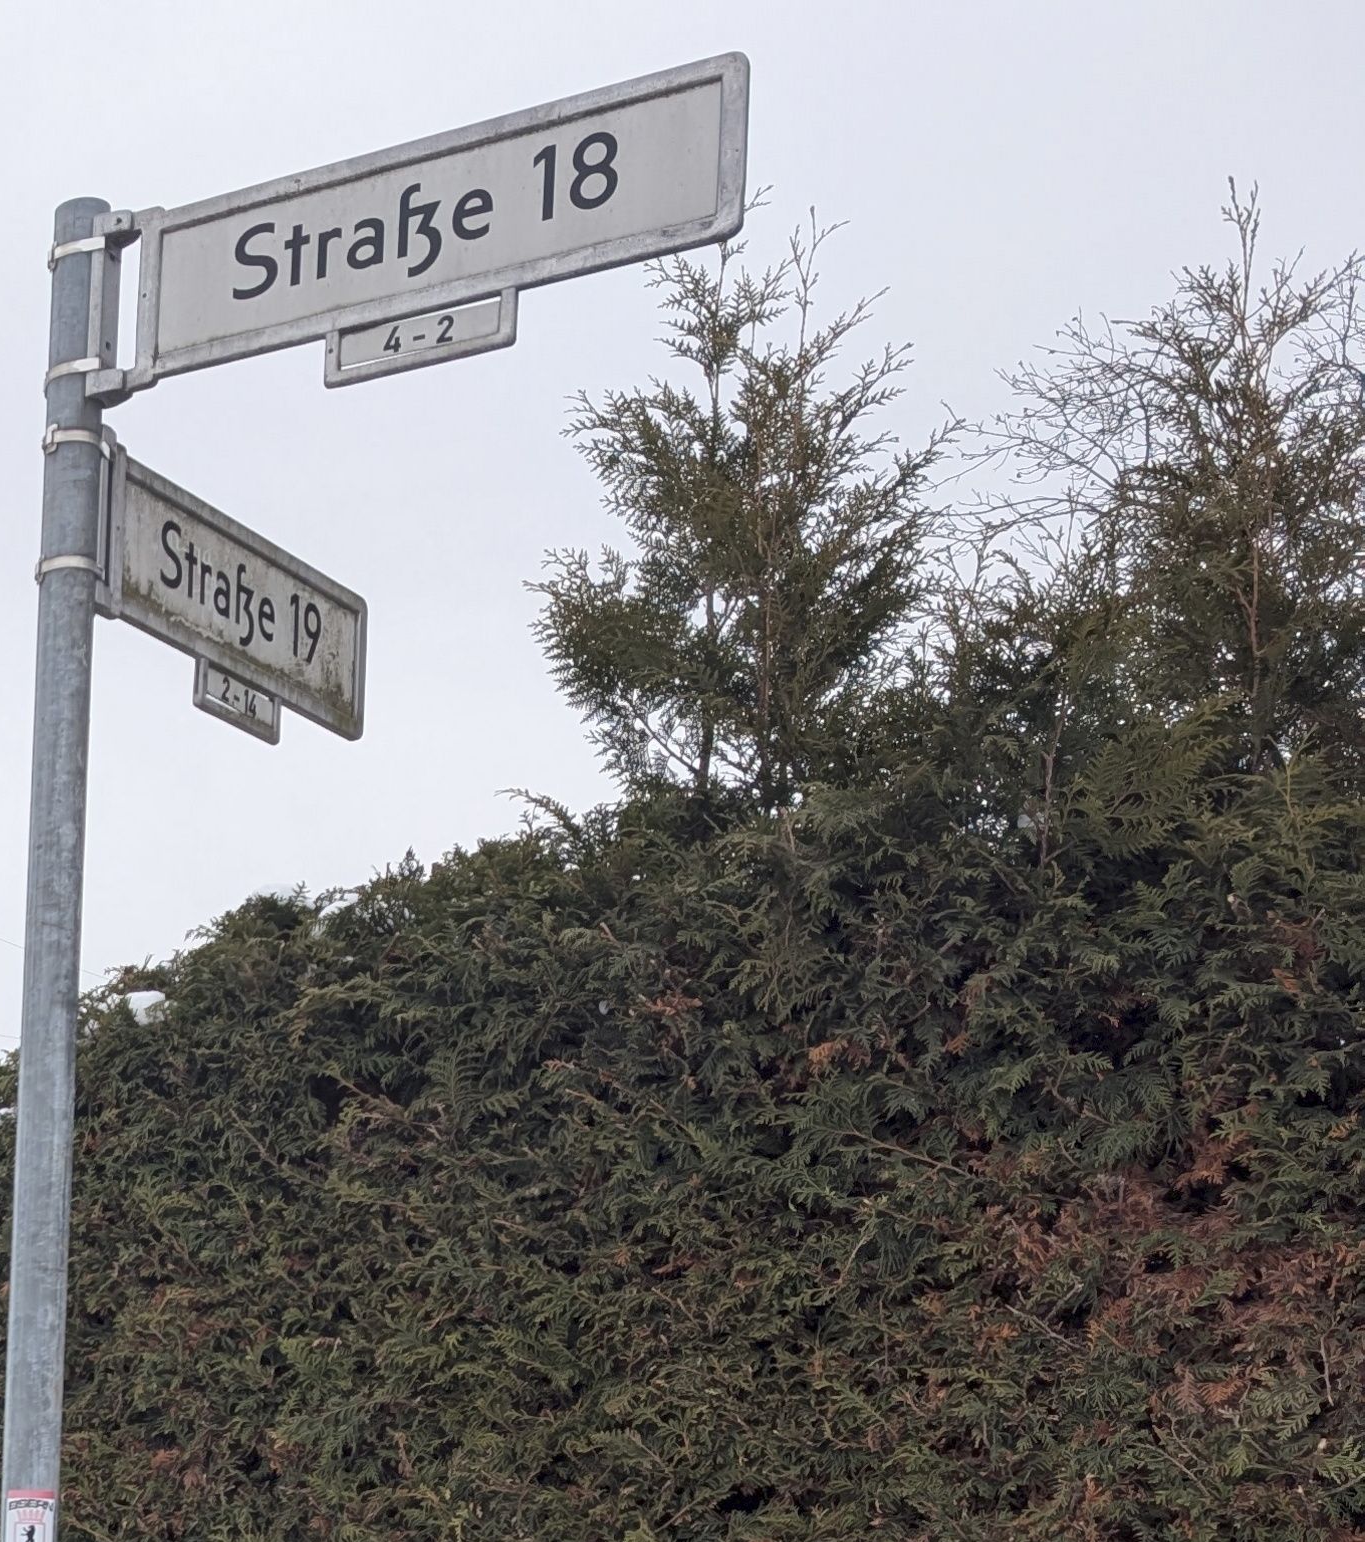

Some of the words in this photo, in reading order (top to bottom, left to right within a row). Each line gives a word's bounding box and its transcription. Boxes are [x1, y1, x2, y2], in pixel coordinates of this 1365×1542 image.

[231, 182, 494, 301] Straße
[531, 131, 619, 222] 18
[159, 520, 276, 647] Straße
[290, 592, 322, 665] 19
